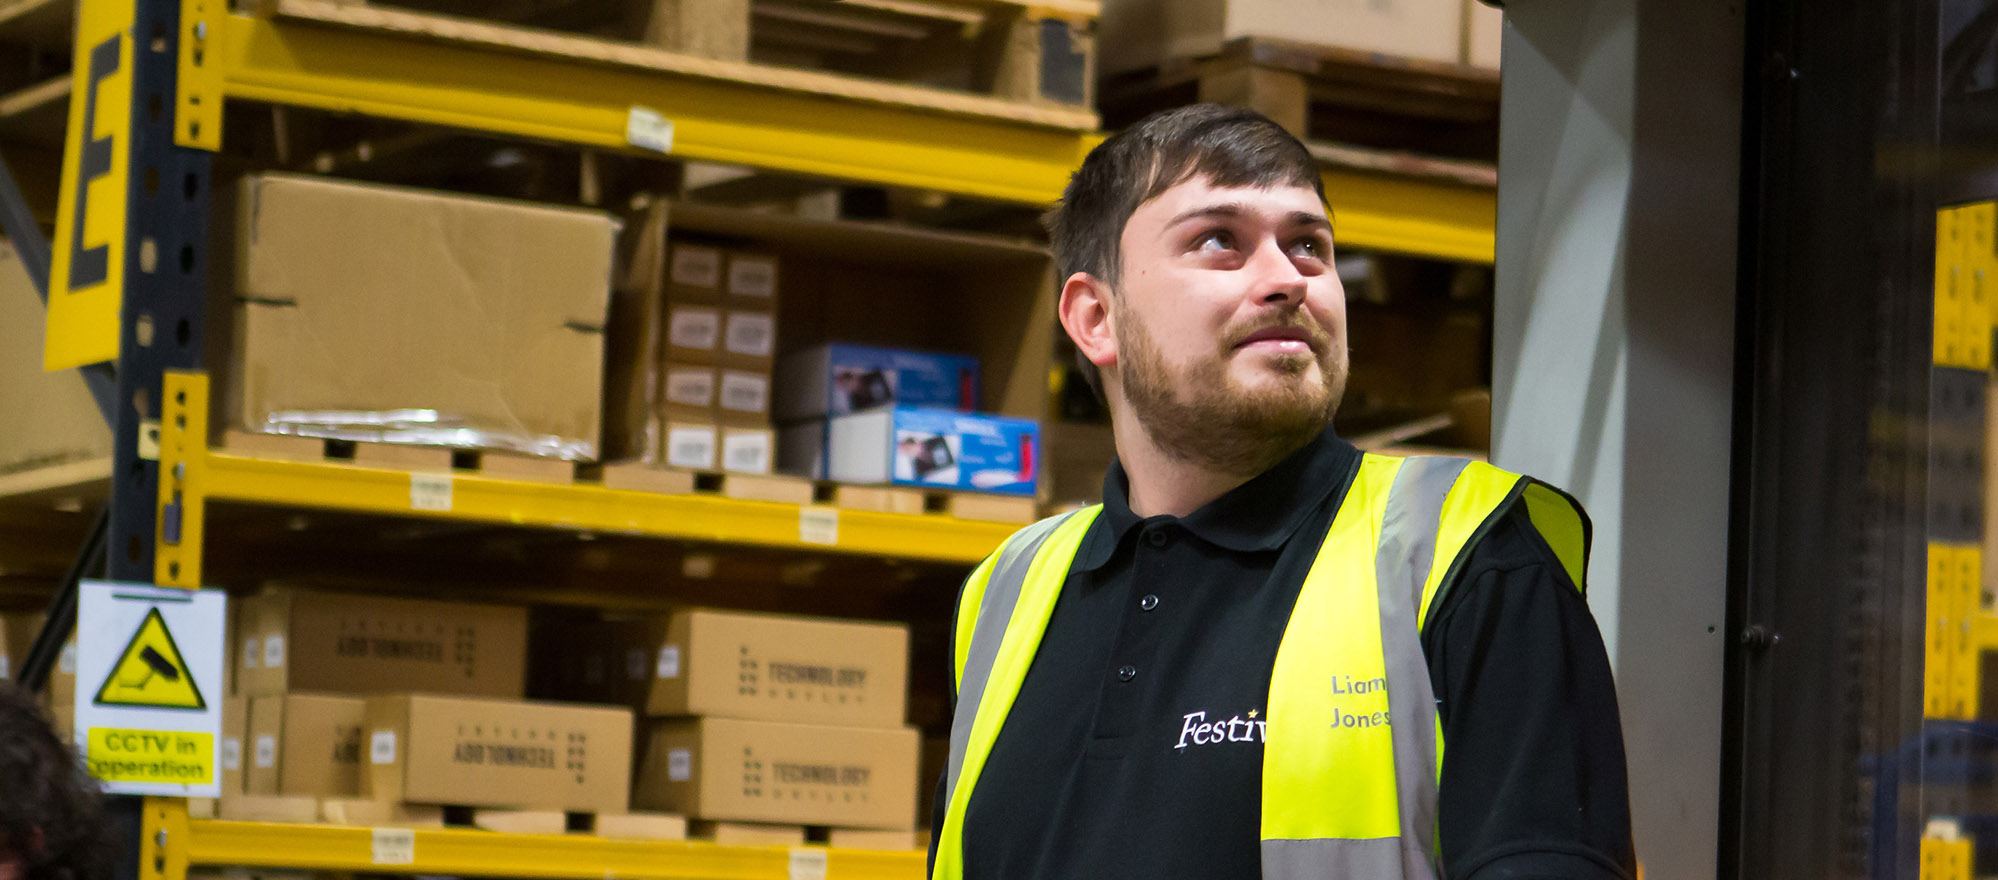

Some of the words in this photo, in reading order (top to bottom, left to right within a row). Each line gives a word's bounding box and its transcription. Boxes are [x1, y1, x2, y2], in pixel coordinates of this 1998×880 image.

[67, 32, 121, 295] E
[769, 662, 867, 688] TECHNOLOGY
[1332, 676, 1386, 694] Liam
[1330, 708, 1391, 728] Jones
[105, 732, 170, 753] CCTV
[176, 735, 197, 755] in
[455, 743, 555, 770] TECHNOLOGY
[772, 762, 872, 787] TECHNOLOGY
